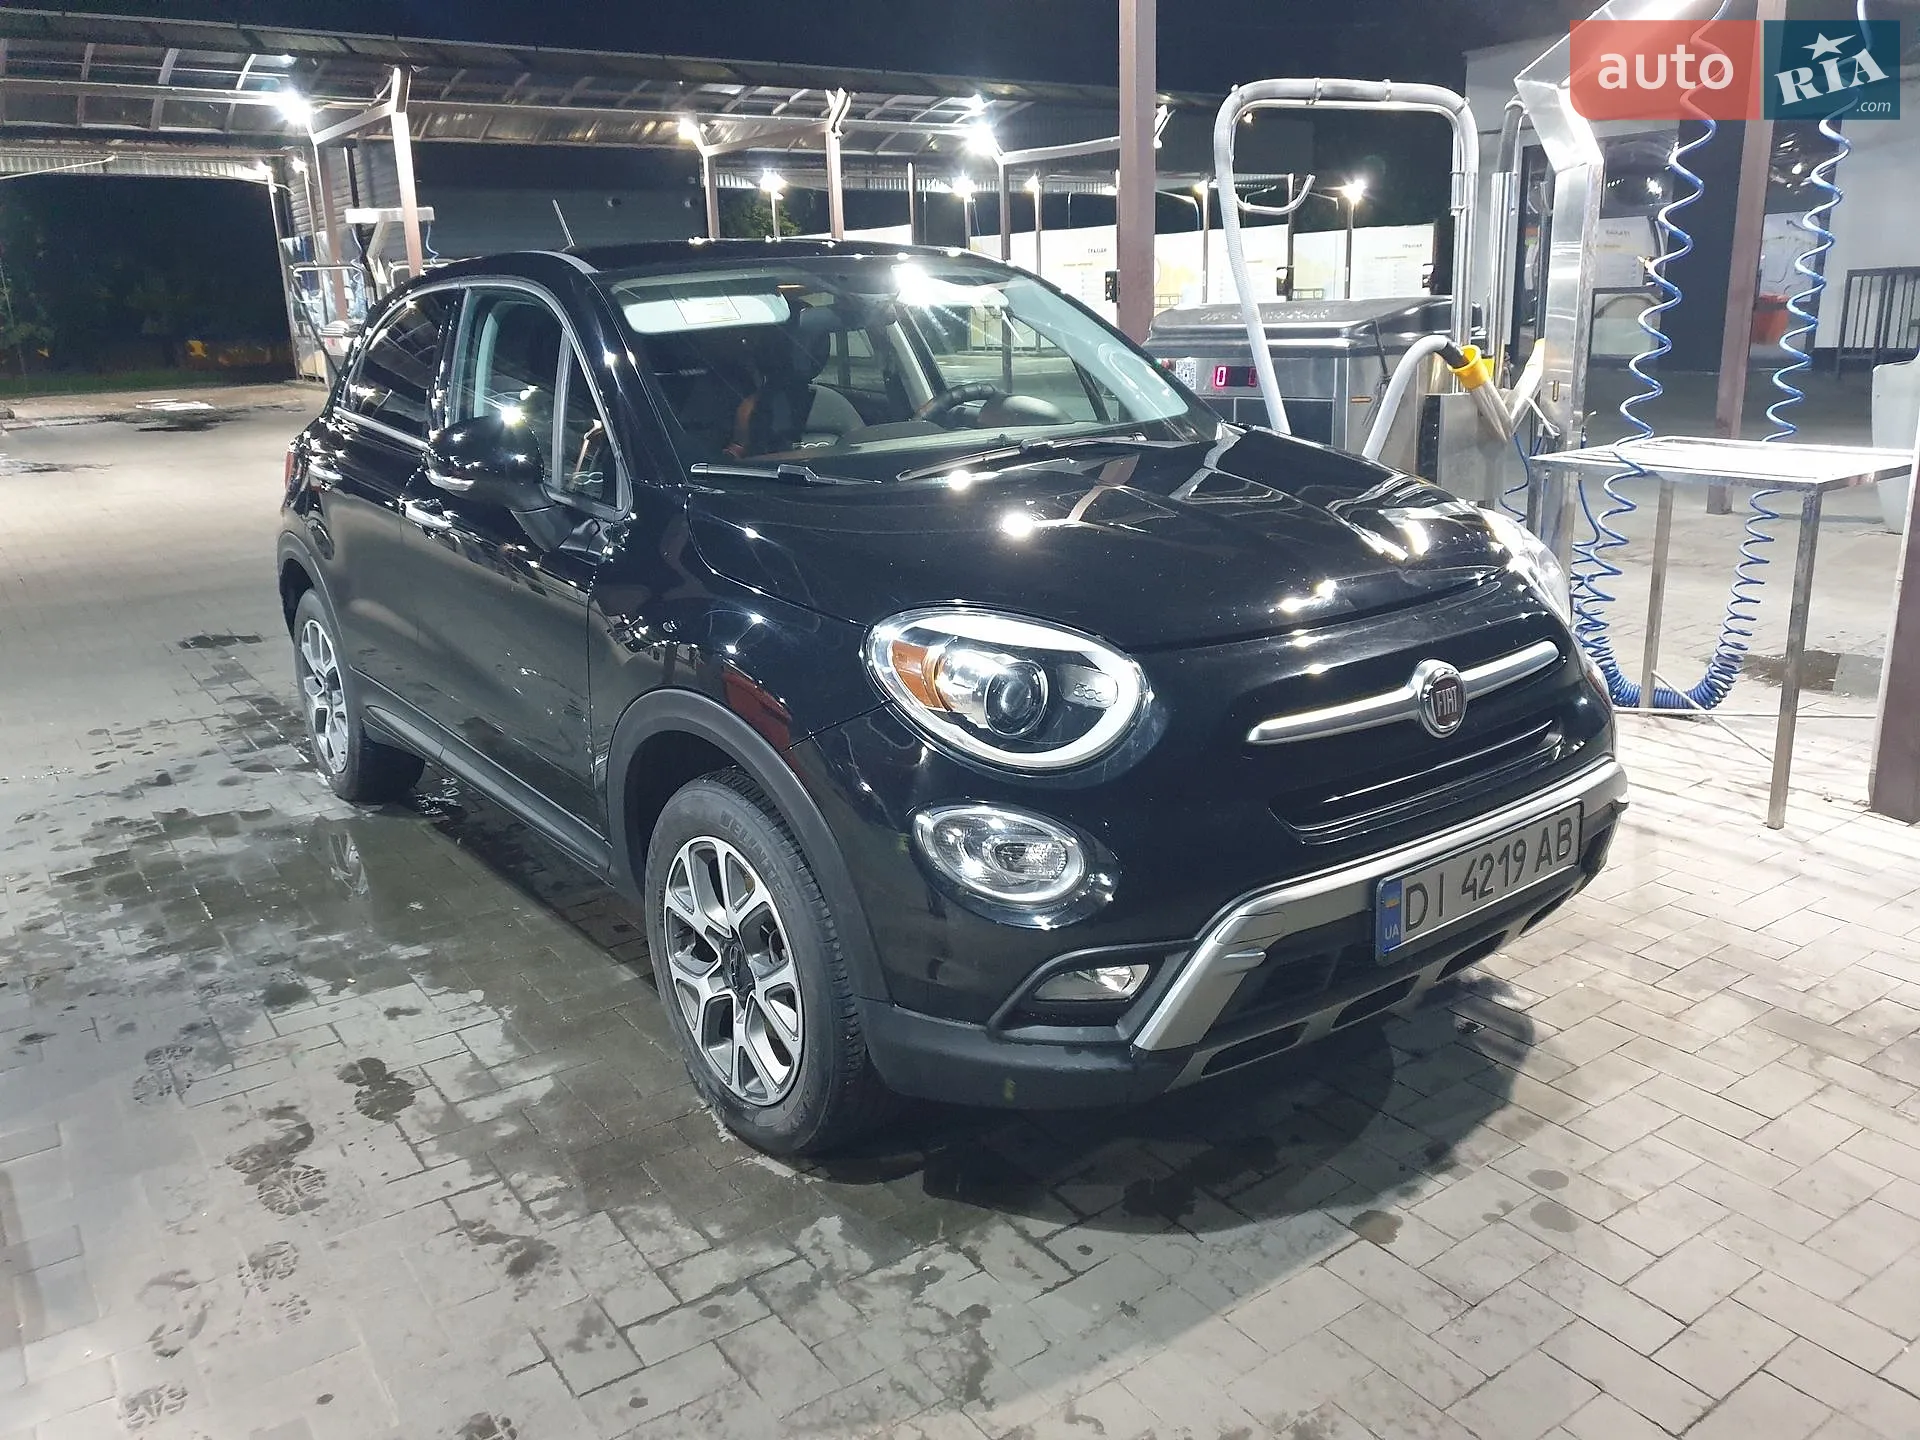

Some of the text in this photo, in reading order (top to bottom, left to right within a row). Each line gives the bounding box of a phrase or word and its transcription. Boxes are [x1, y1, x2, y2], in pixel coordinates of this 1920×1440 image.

[1435, 685, 1458, 717] FIAT
[1405, 818, 1572, 932] DI 4219 AB
[1384, 926, 1400, 940] UA
